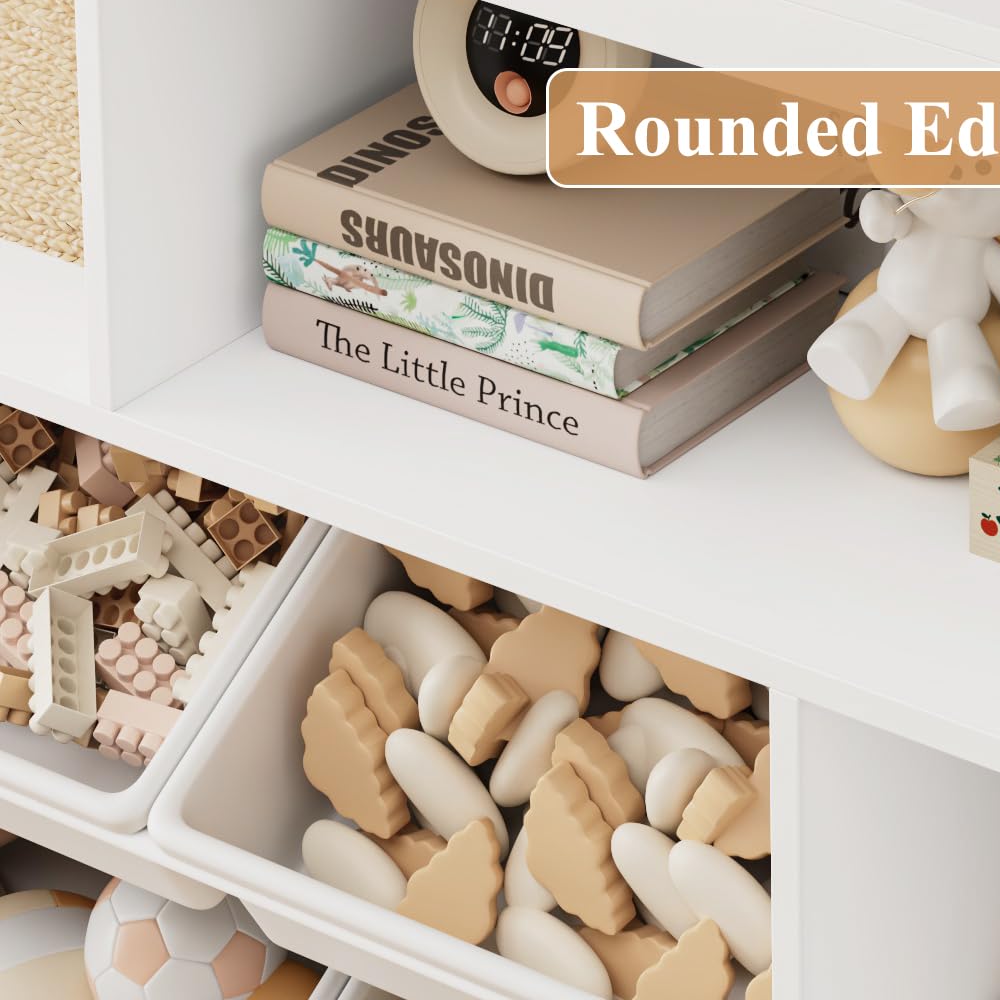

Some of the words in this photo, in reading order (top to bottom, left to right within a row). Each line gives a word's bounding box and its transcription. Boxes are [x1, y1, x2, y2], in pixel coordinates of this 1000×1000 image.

[481, 12, 574, 67] 11:09
[340, 209, 555, 313] DINOSAURS
[315, 318, 371, 364] The
[381, 341, 467, 397] Little
[476, 375, 580, 436] Prince
